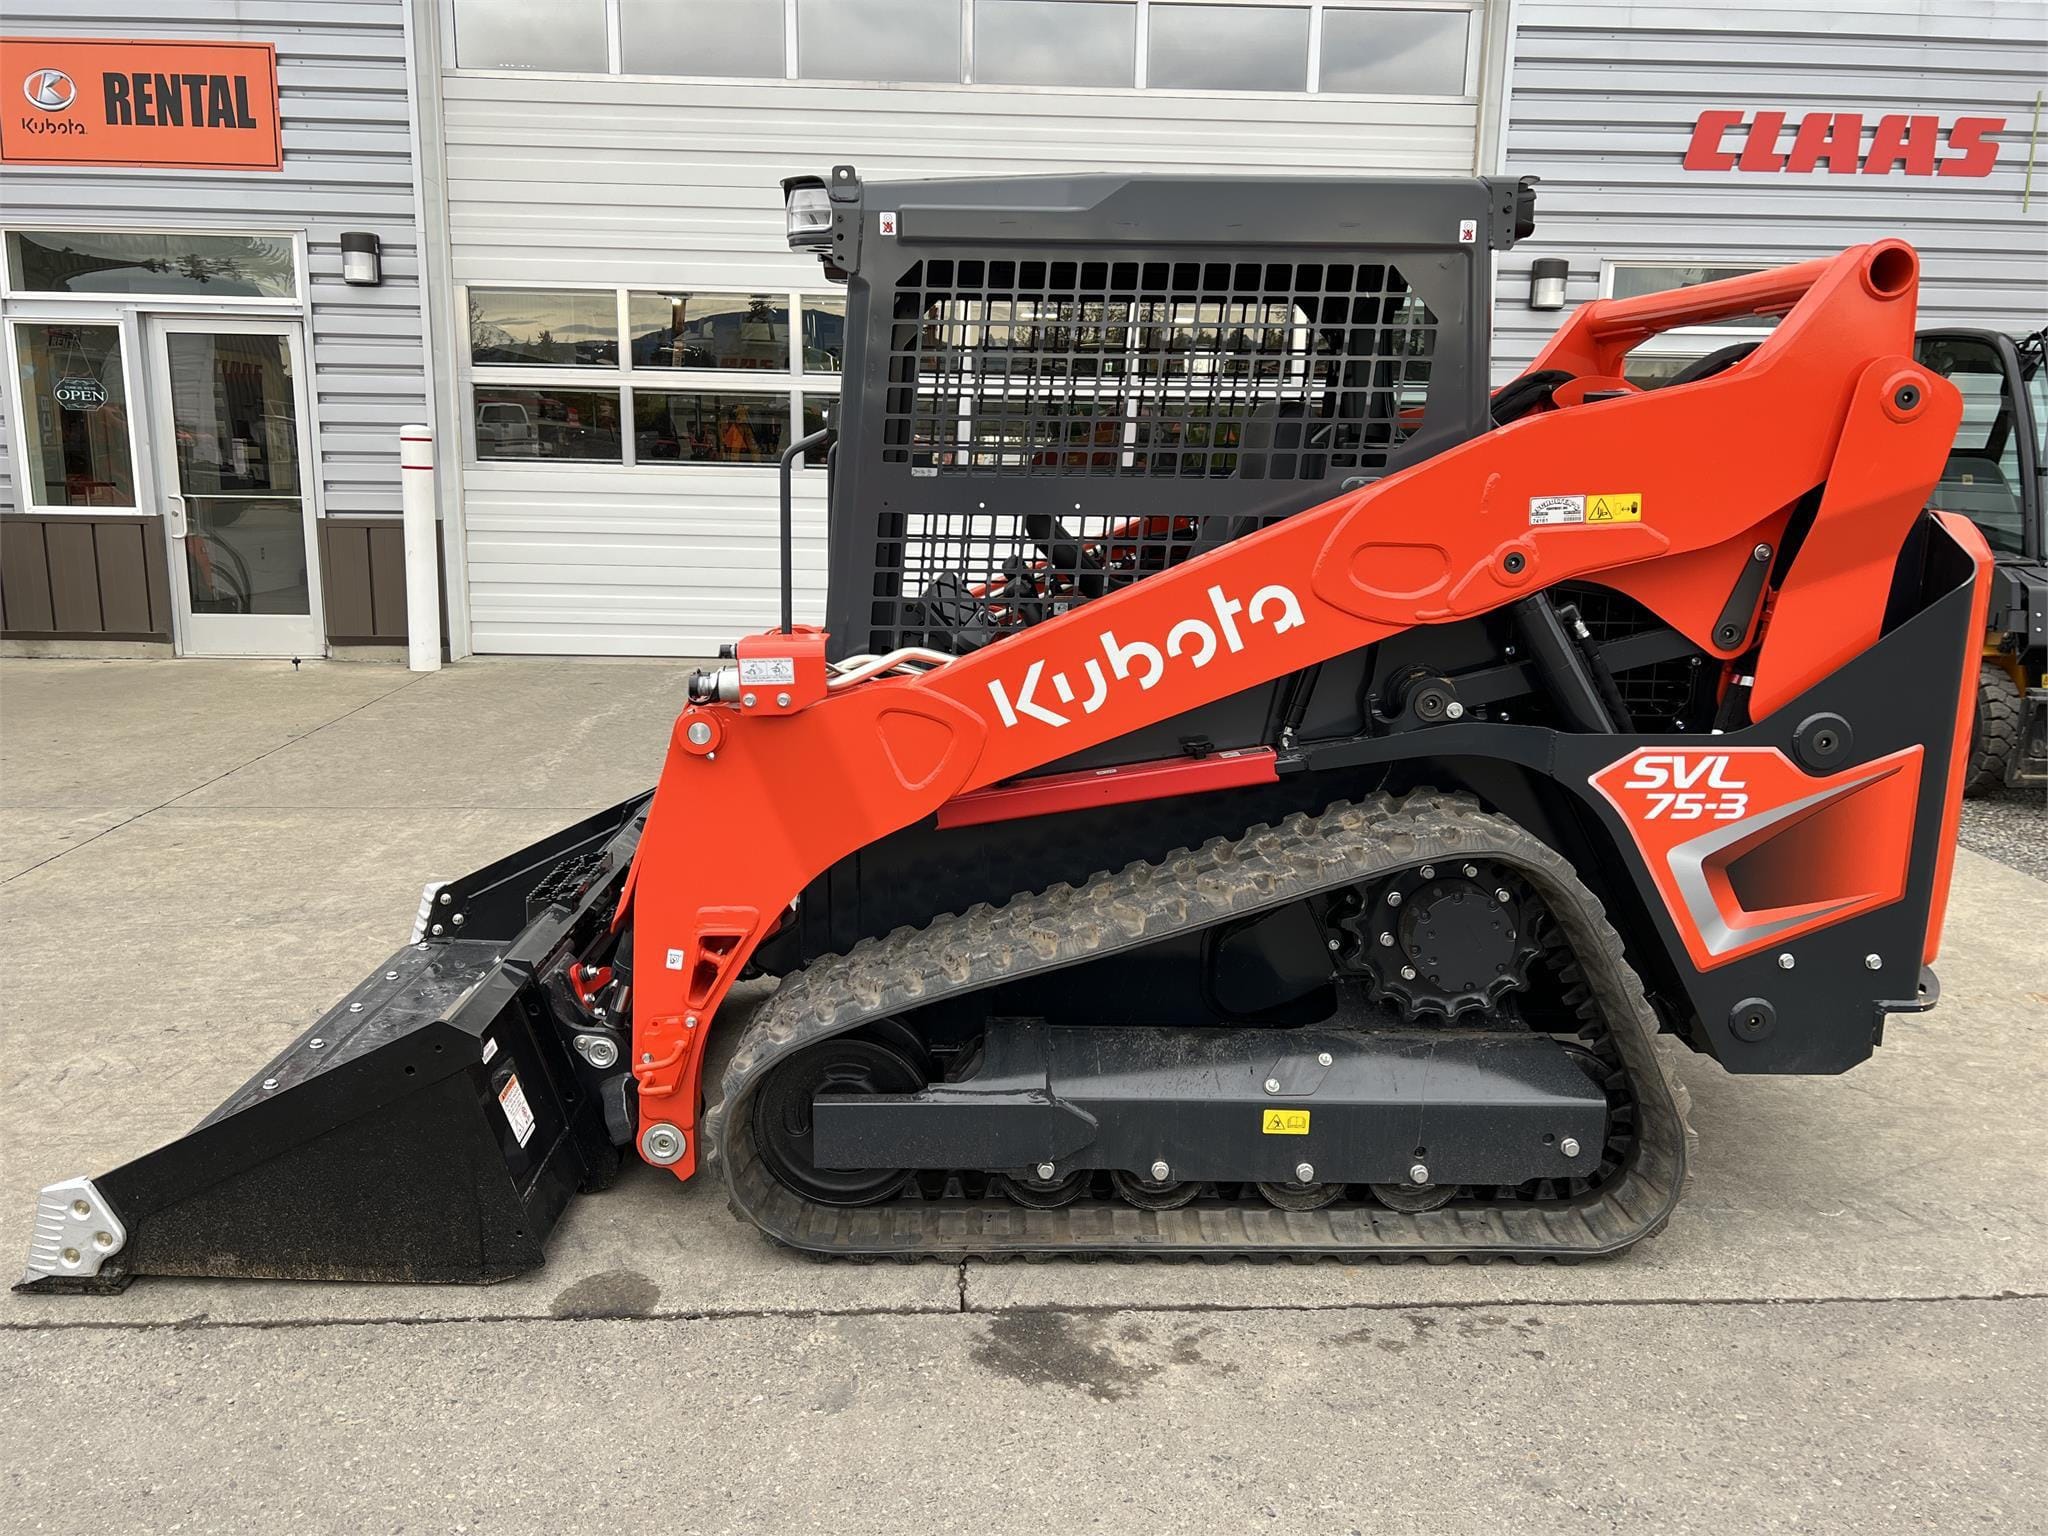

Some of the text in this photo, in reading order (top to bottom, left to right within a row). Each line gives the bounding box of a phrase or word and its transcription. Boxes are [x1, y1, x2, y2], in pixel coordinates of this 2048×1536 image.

[103, 72, 257, 129] RENTAL
[21, 117, 87, 136] Kubota
[1682, 110, 2007, 178] CLAAS
[56, 389, 105, 402] OPEN
[987, 584, 1306, 729] Kubota
[1624, 756, 1747, 789] SVL
[1644, 793, 1749, 820] 75-3
